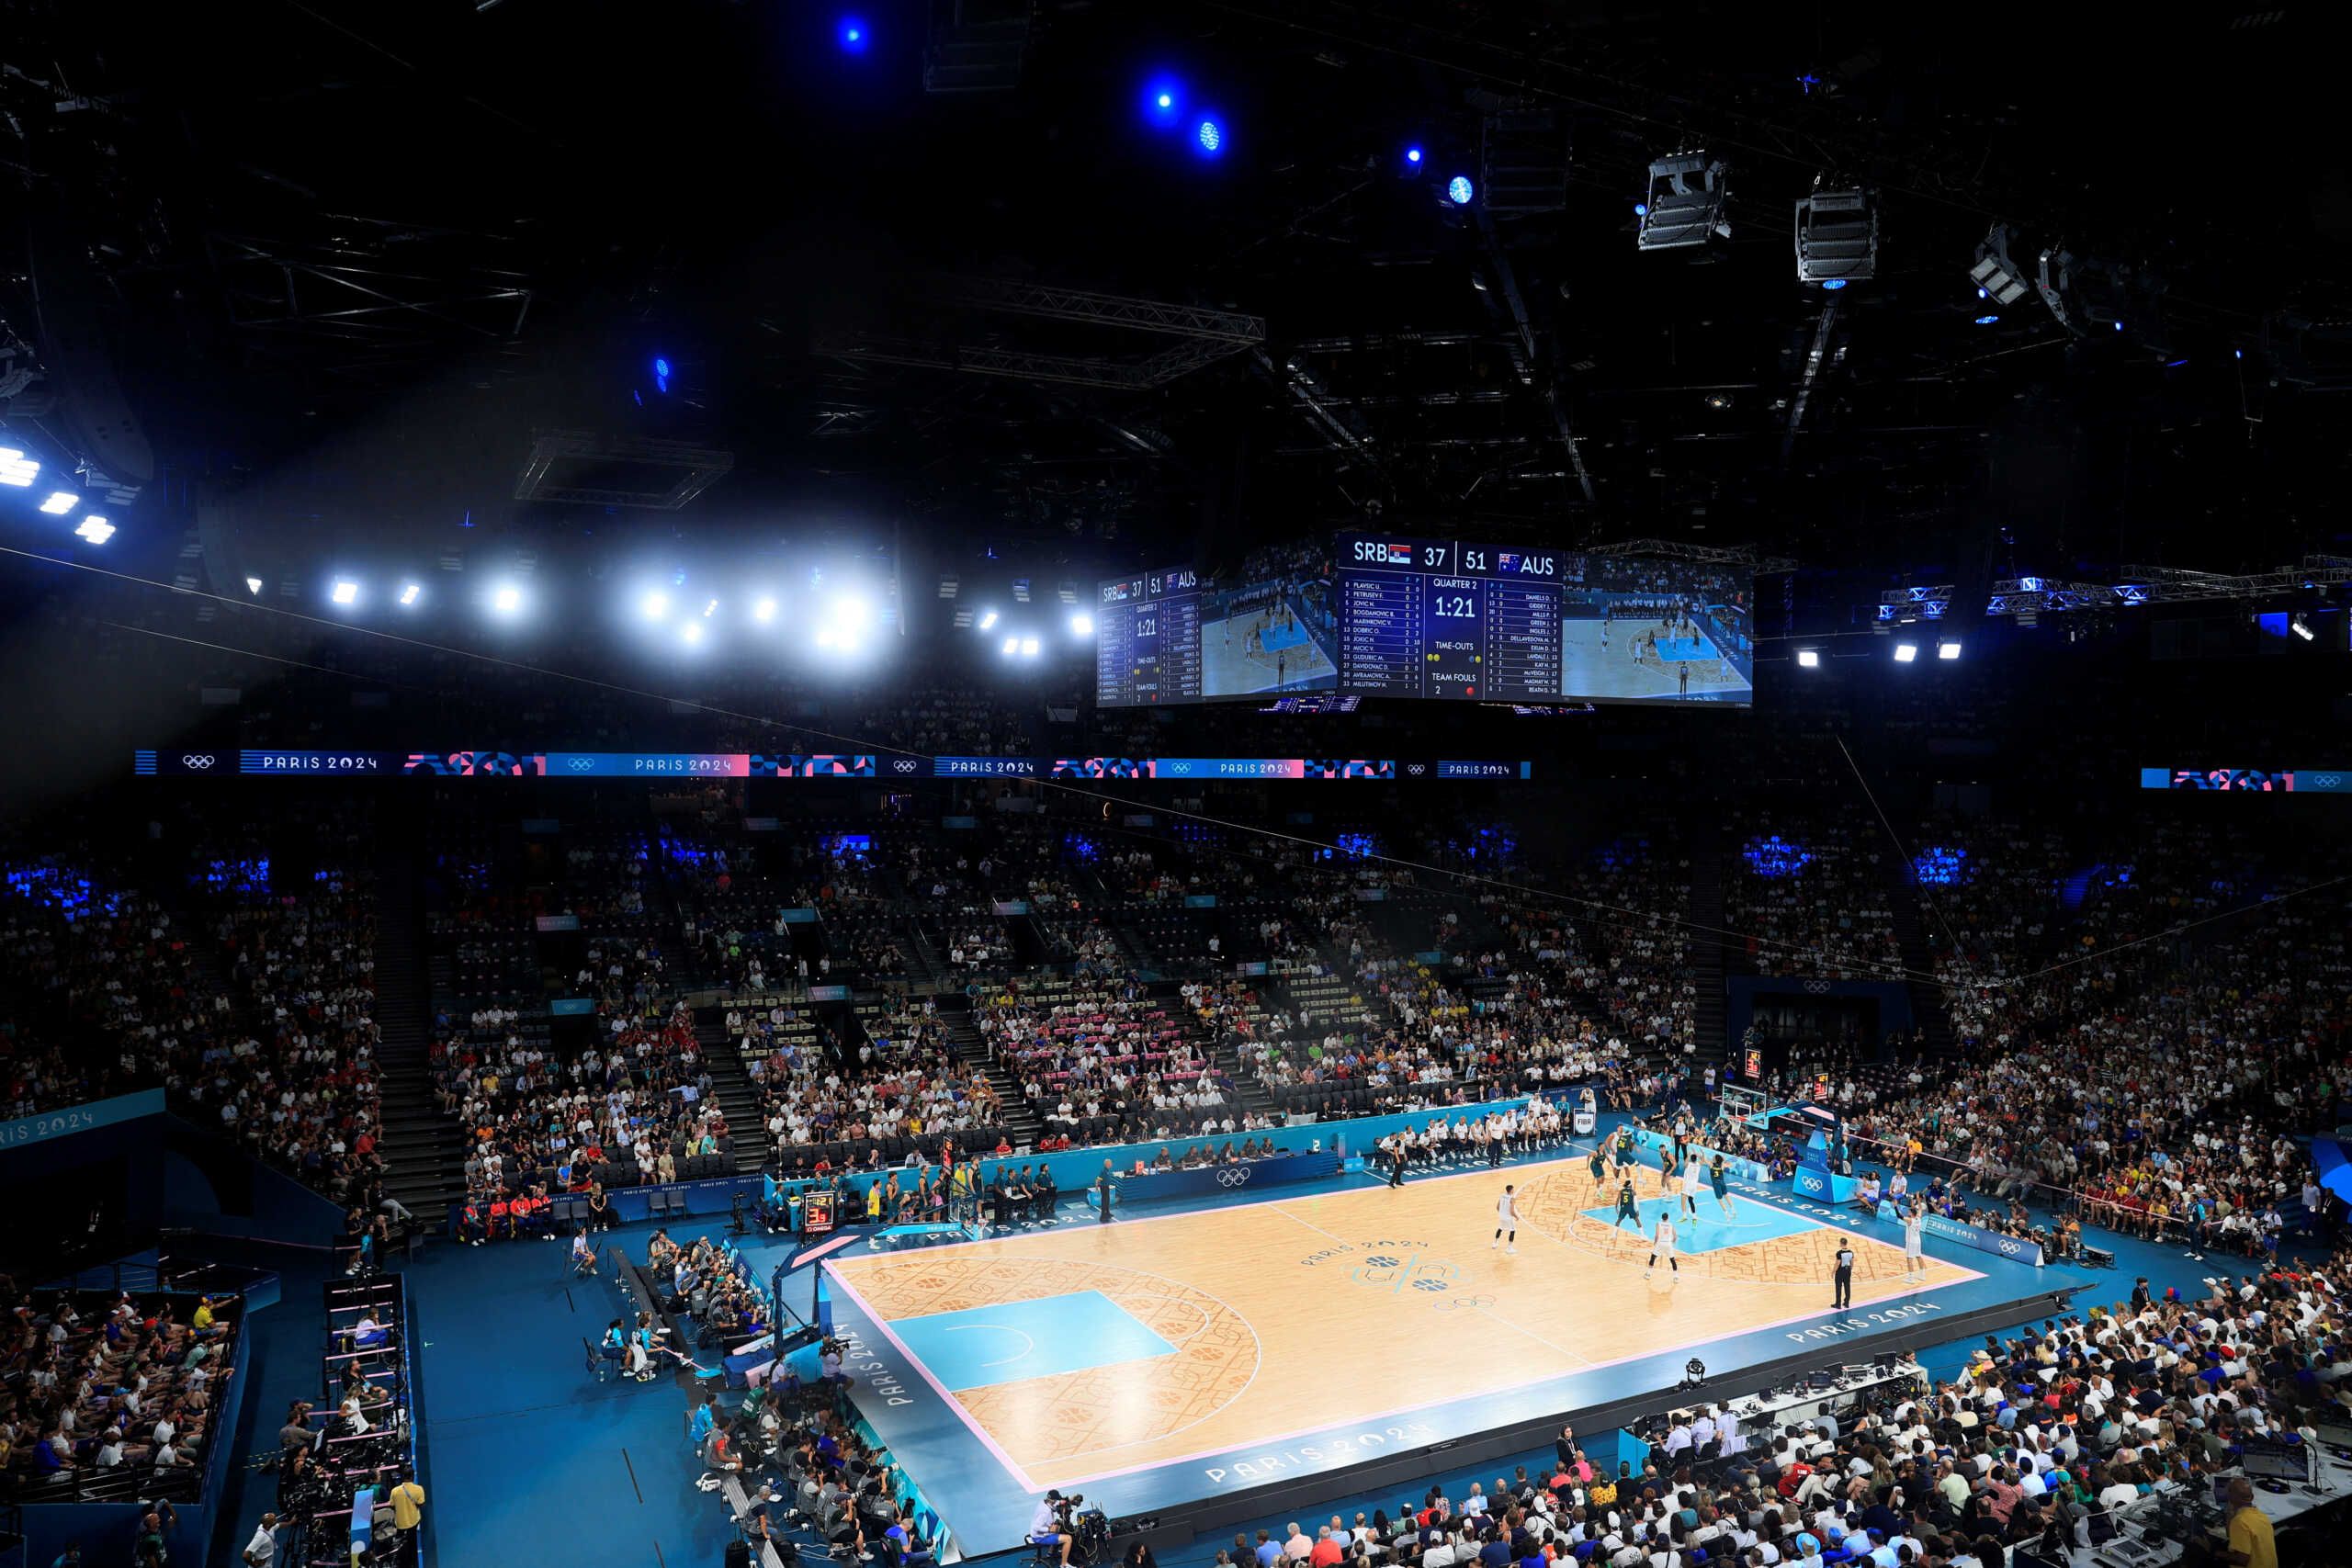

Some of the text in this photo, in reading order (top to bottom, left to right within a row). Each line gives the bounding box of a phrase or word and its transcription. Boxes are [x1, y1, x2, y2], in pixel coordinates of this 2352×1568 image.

[1354, 541, 1387, 562] SRB
[1425, 547, 1446, 566] 37
[1465, 551, 1486, 570] 51
[1520, 556, 1553, 575] AUS
[1151, 577, 1161, 593] 51
[1178, 570, 1196, 588] AUS
[1433, 578, 1477, 589] QUARTER 2
[1104, 586, 1117, 603] SRB
[1132, 581, 1142, 597] 37
[1435, 596, 1476, 618] 1:21
[1138, 618, 1156, 637] 1:21
[1435, 641, 1474, 650] TIME-OUTS
[1453, 674, 1476, 682] FOULS
[1436, 686, 1441, 694] 2
[264, 757, 377, 768] PARIS 2024
[635, 759, 731, 770] PARIS 2024
[951, 762, 1034, 772] PARIS 2024
[1221, 764, 1290, 773] PARIS 2024
[1449, 766, 1509, 774] PARIS 2024
[38, 1111, 93, 1136] 2024
[1727, 1182, 1862, 1227] PARIS 2024
[1021, 1214, 1095, 1229] 2024
[1931, 1221, 1978, 1241] PARIS 2024
[1300, 1245, 1354, 1266] PARIS
[1786, 1303, 1941, 1343] PARIS 2024
[859, 1362, 914, 1406] PARIS
[1205, 1423, 1434, 1483] PARIS 2024
